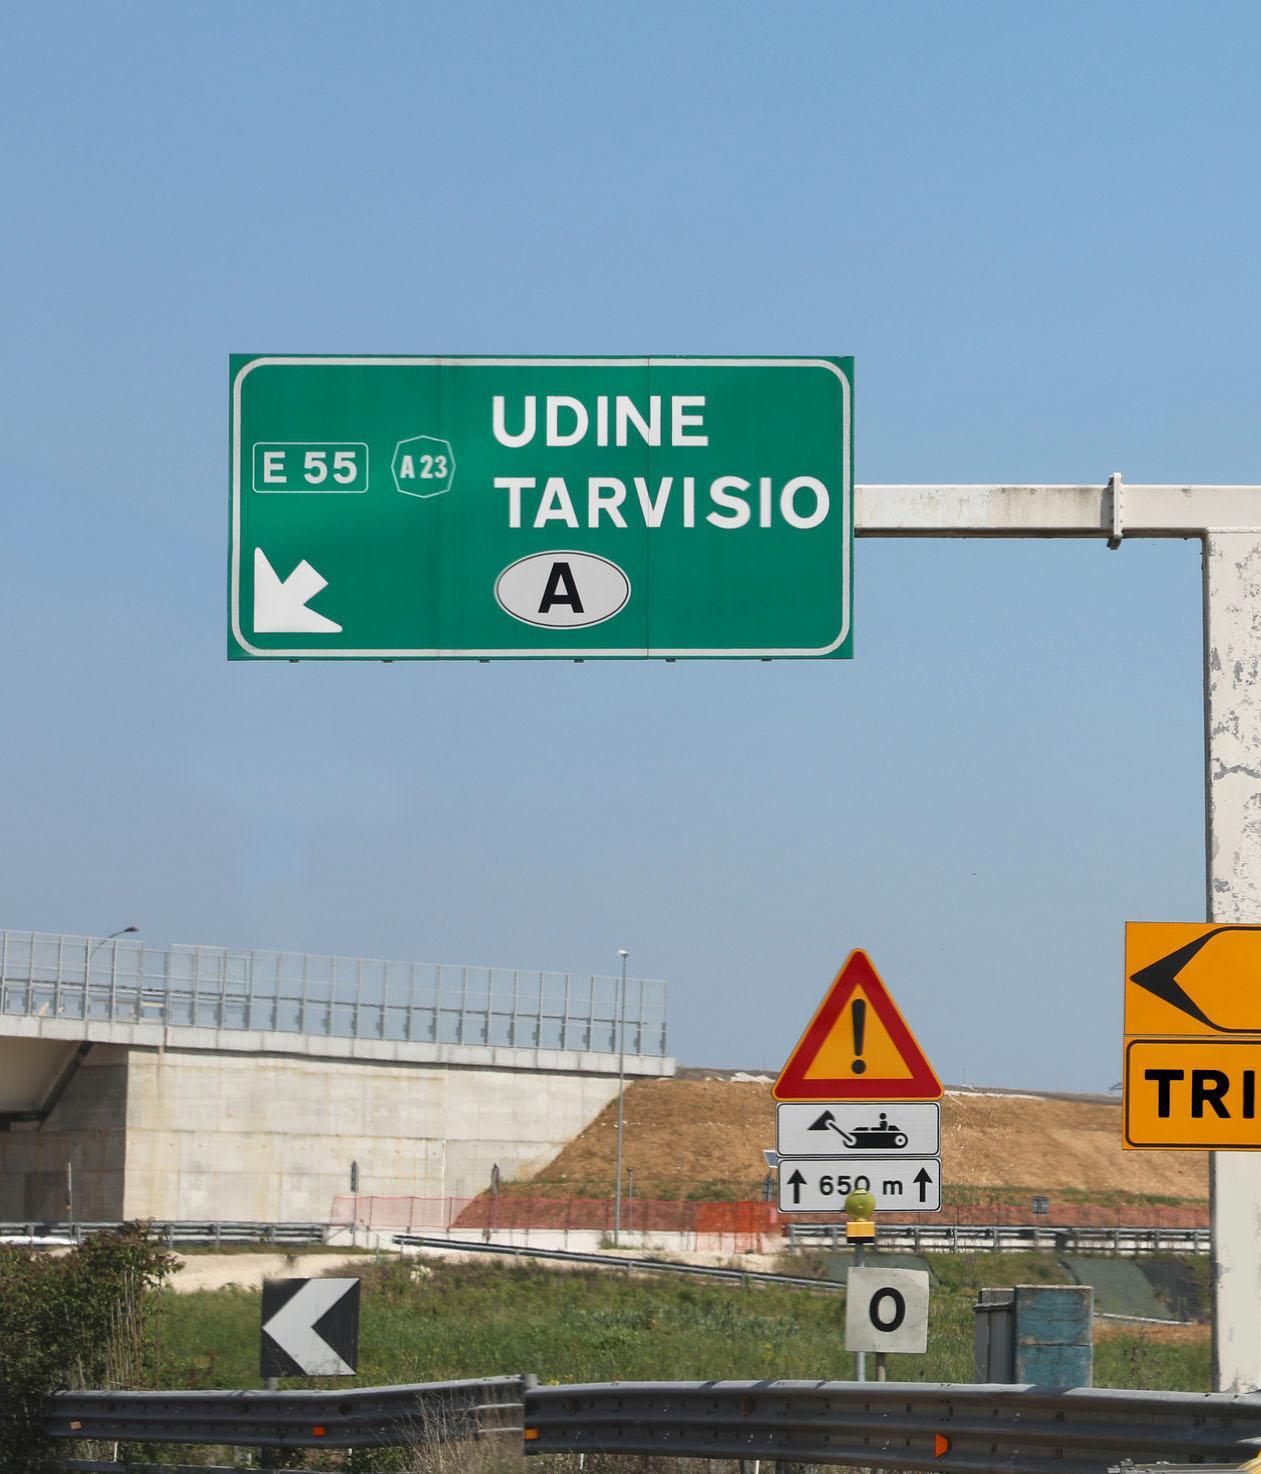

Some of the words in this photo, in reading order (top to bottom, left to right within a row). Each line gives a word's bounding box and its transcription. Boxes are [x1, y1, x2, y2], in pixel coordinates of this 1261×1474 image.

[493, 396, 708, 447] UDINE
[263, 452, 287, 483] E
[303, 452, 358, 483] 55
[494, 476, 830, 528] TARVISIO
[538, 562, 584, 613] A
[820, 1175, 870, 1195] 650
[883, 1180, 903, 1195] m
